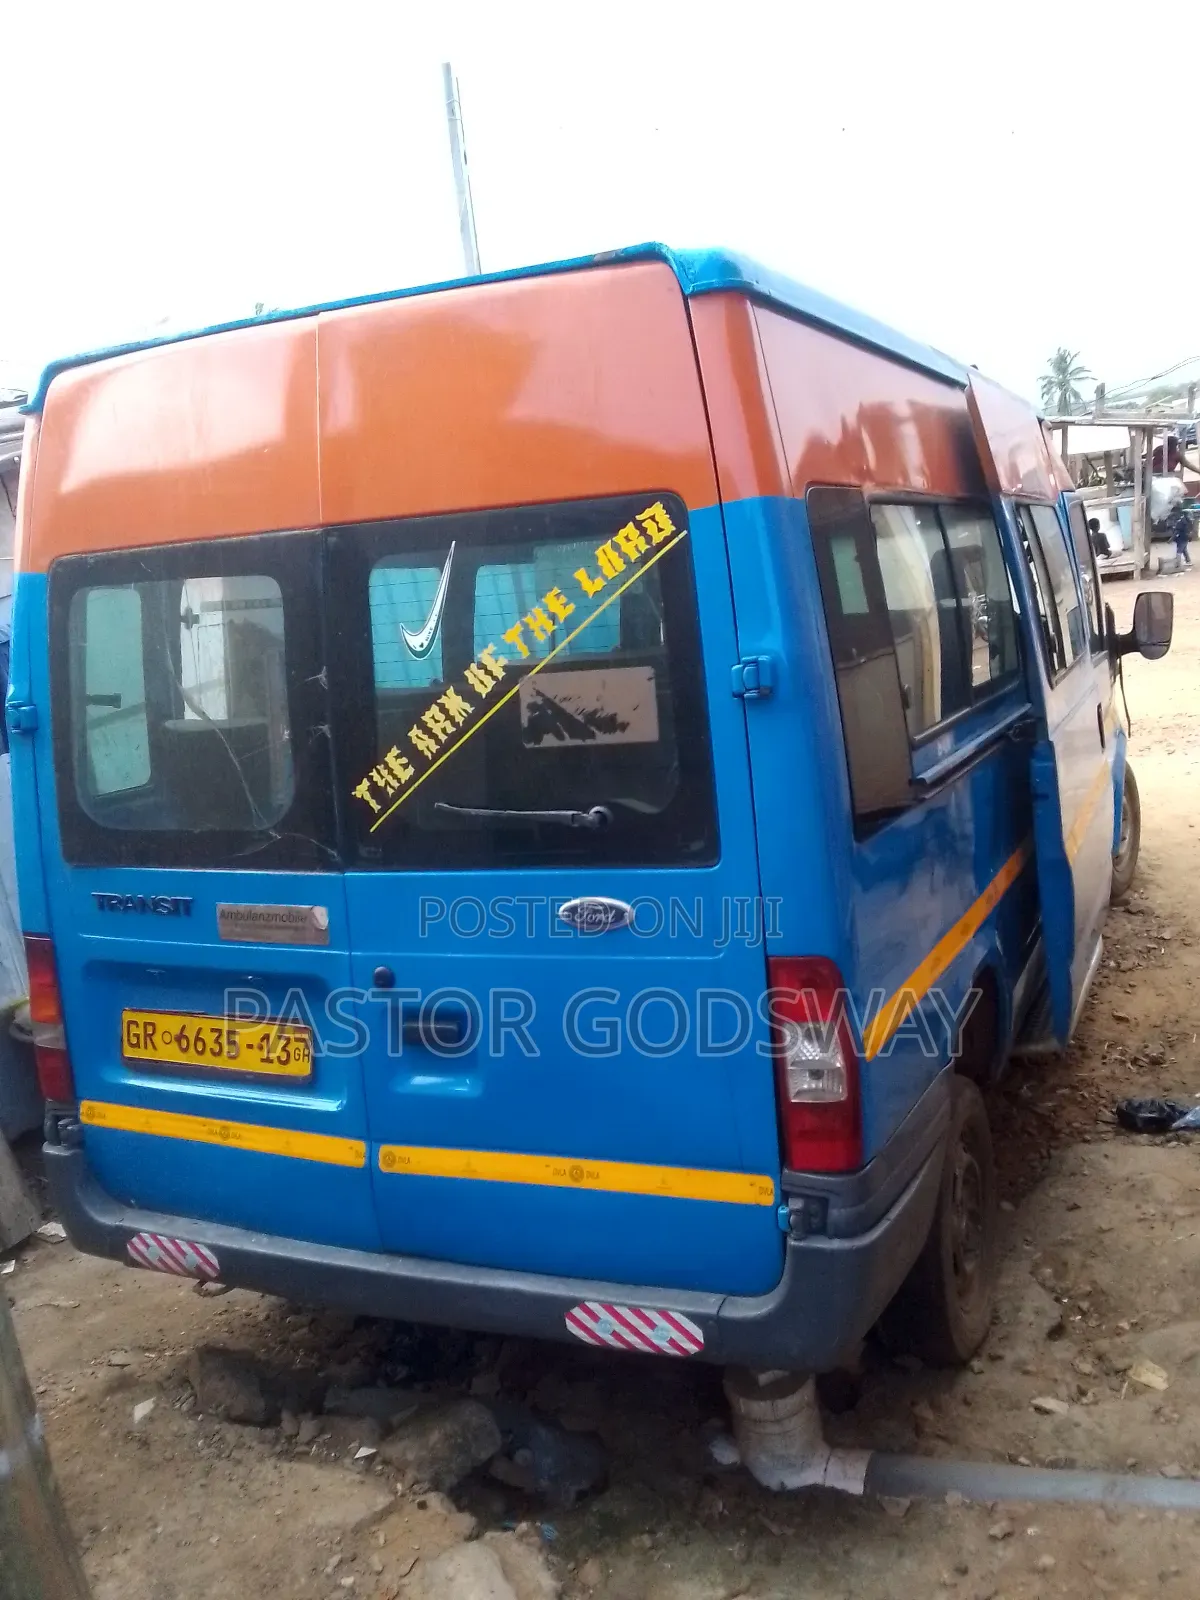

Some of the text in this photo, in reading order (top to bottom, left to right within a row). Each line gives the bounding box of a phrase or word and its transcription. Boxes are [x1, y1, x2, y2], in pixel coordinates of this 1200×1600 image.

[351, 501, 676, 814] THE ARK OF THE LORD
[91, 892, 194, 916] TRANSIT
[574, 903, 616, 923] Ford
[126, 1019, 157, 1051] GR
